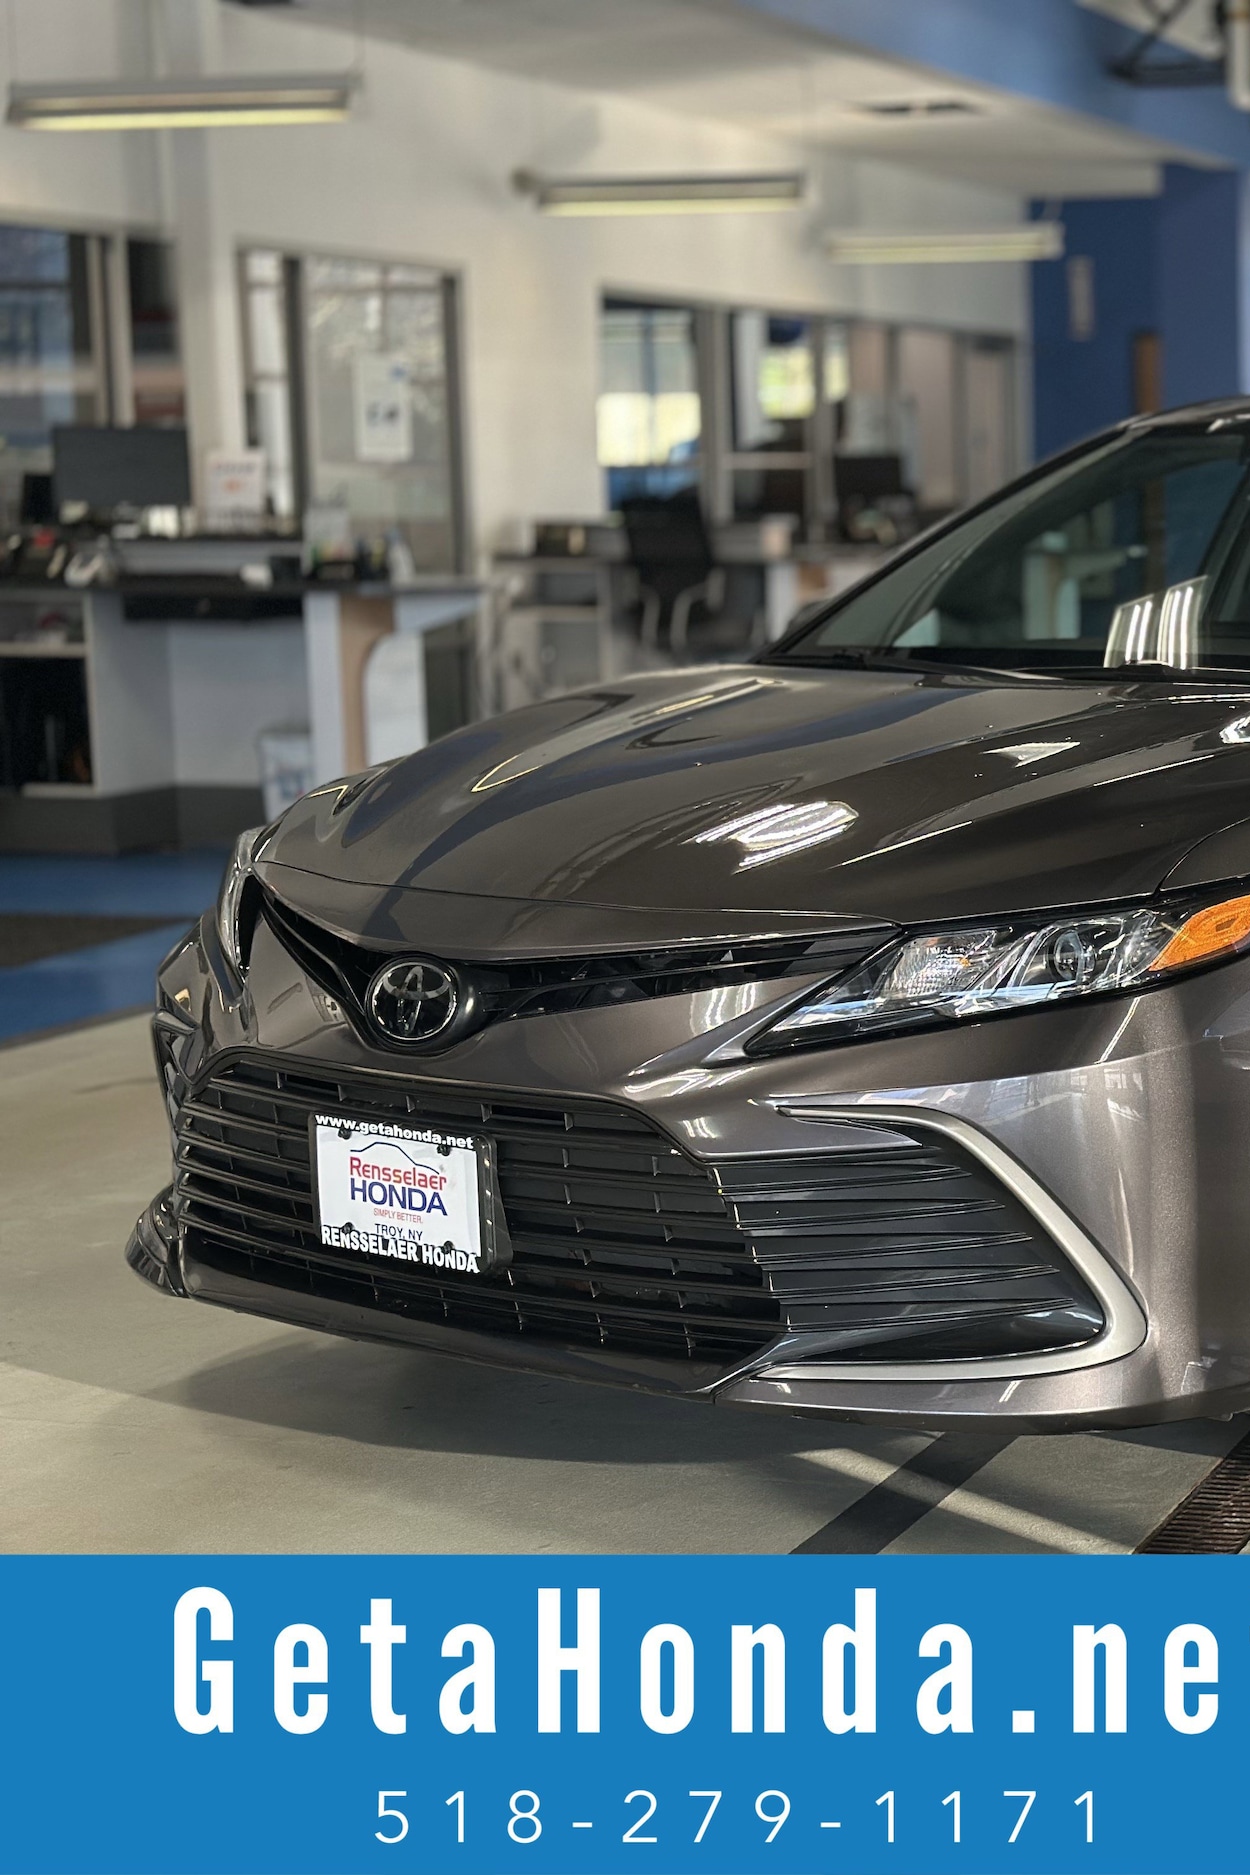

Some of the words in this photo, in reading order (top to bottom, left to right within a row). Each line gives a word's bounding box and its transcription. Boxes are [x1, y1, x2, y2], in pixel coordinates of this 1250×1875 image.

[315, 1115, 473, 1149] www.getahonda.net
[350, 1157, 447, 1190] Rensselaer
[350, 1178, 448, 1216] HONDA
[373, 1208, 396, 1219] SIMPLY
[322, 1225, 419, 1262] RENSSELAER
[422, 1245, 480, 1273] HONDA
[408, 1229, 423, 1241] NY
